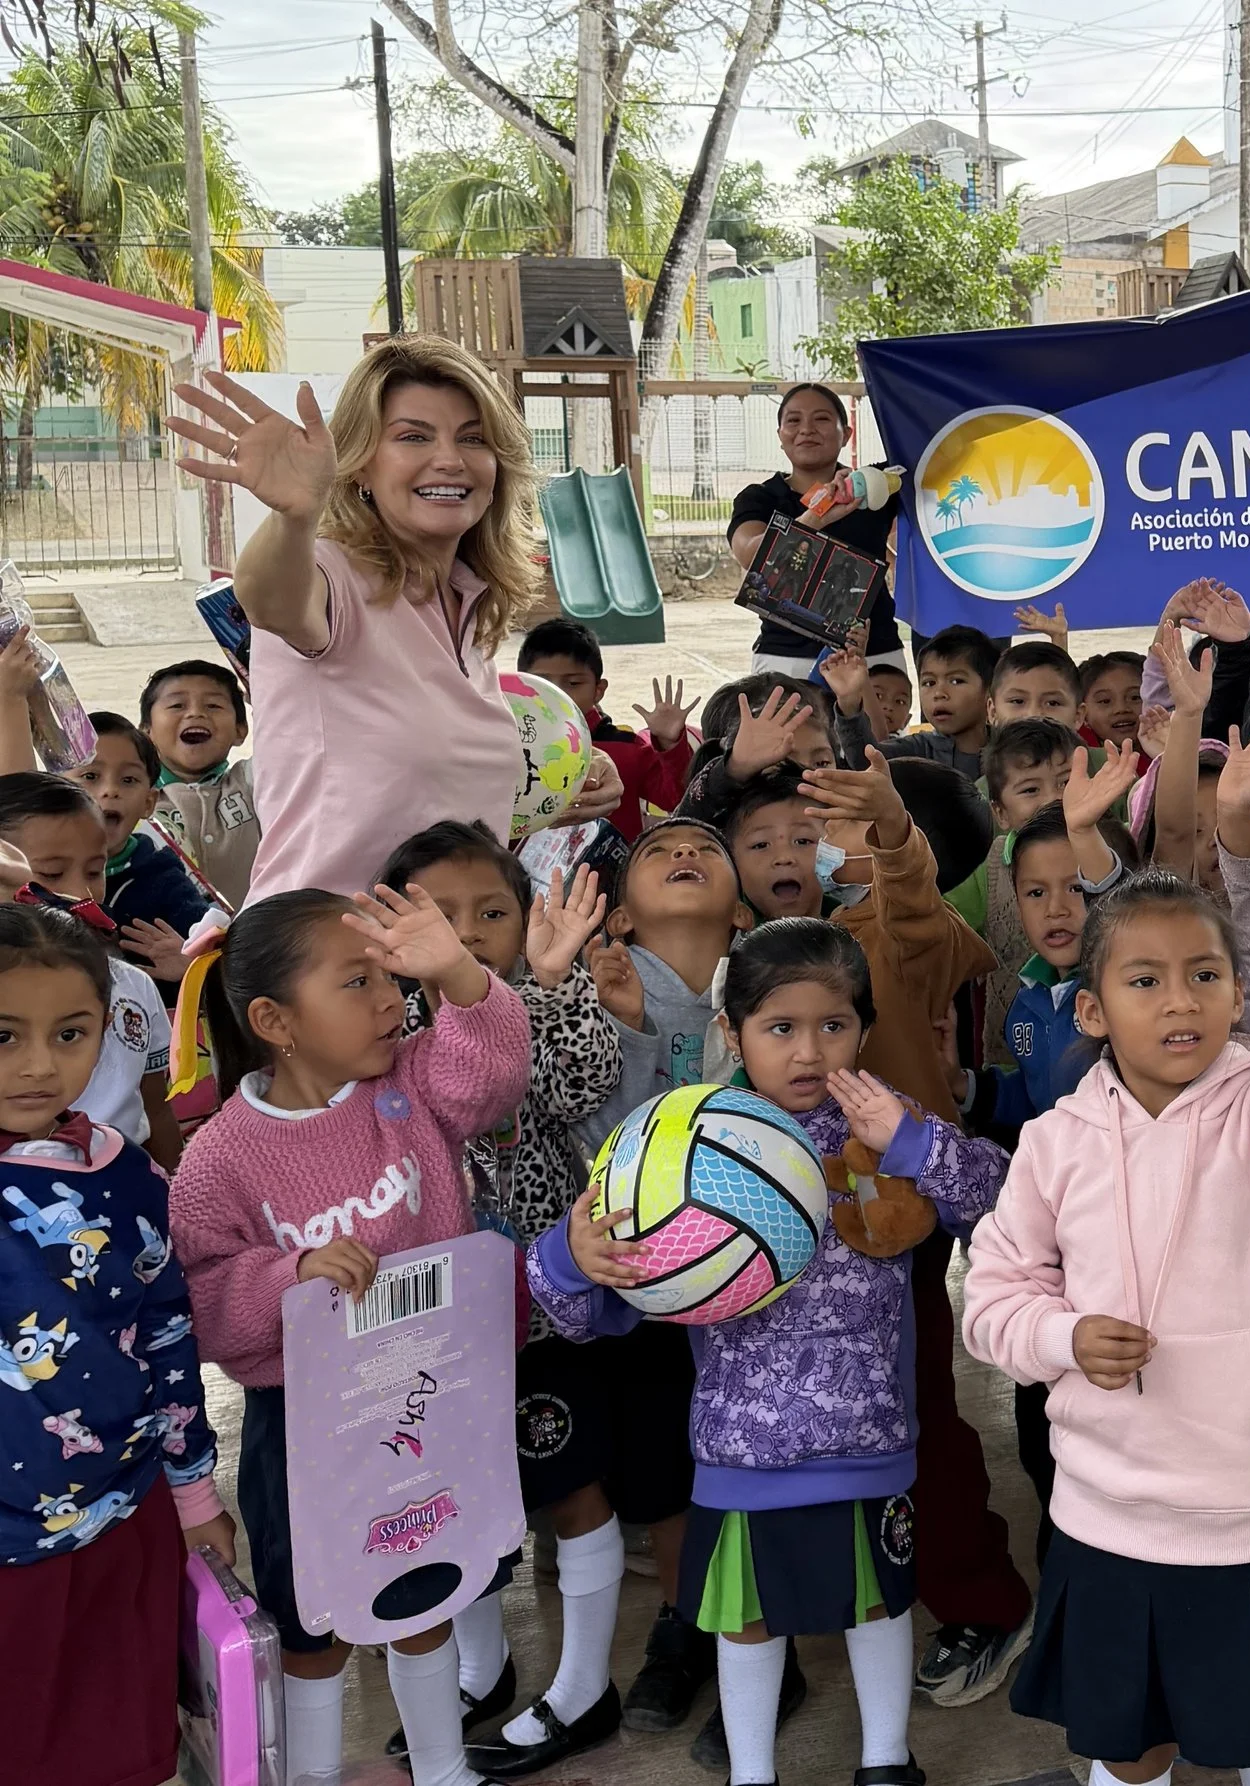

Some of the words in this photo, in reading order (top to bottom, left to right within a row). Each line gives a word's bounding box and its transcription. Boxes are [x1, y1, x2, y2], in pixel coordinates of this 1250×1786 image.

[1131, 507, 1234, 530] Asociación
[1149, 531, 1213, 551] Puerto
[218, 791, 254, 830] H
[1012, 1022, 1034, 1056] 98
[262, 1150, 422, 1252] honey
[401, 1262, 429, 1277] 81307
[443, 1256, 449, 1266] 6
